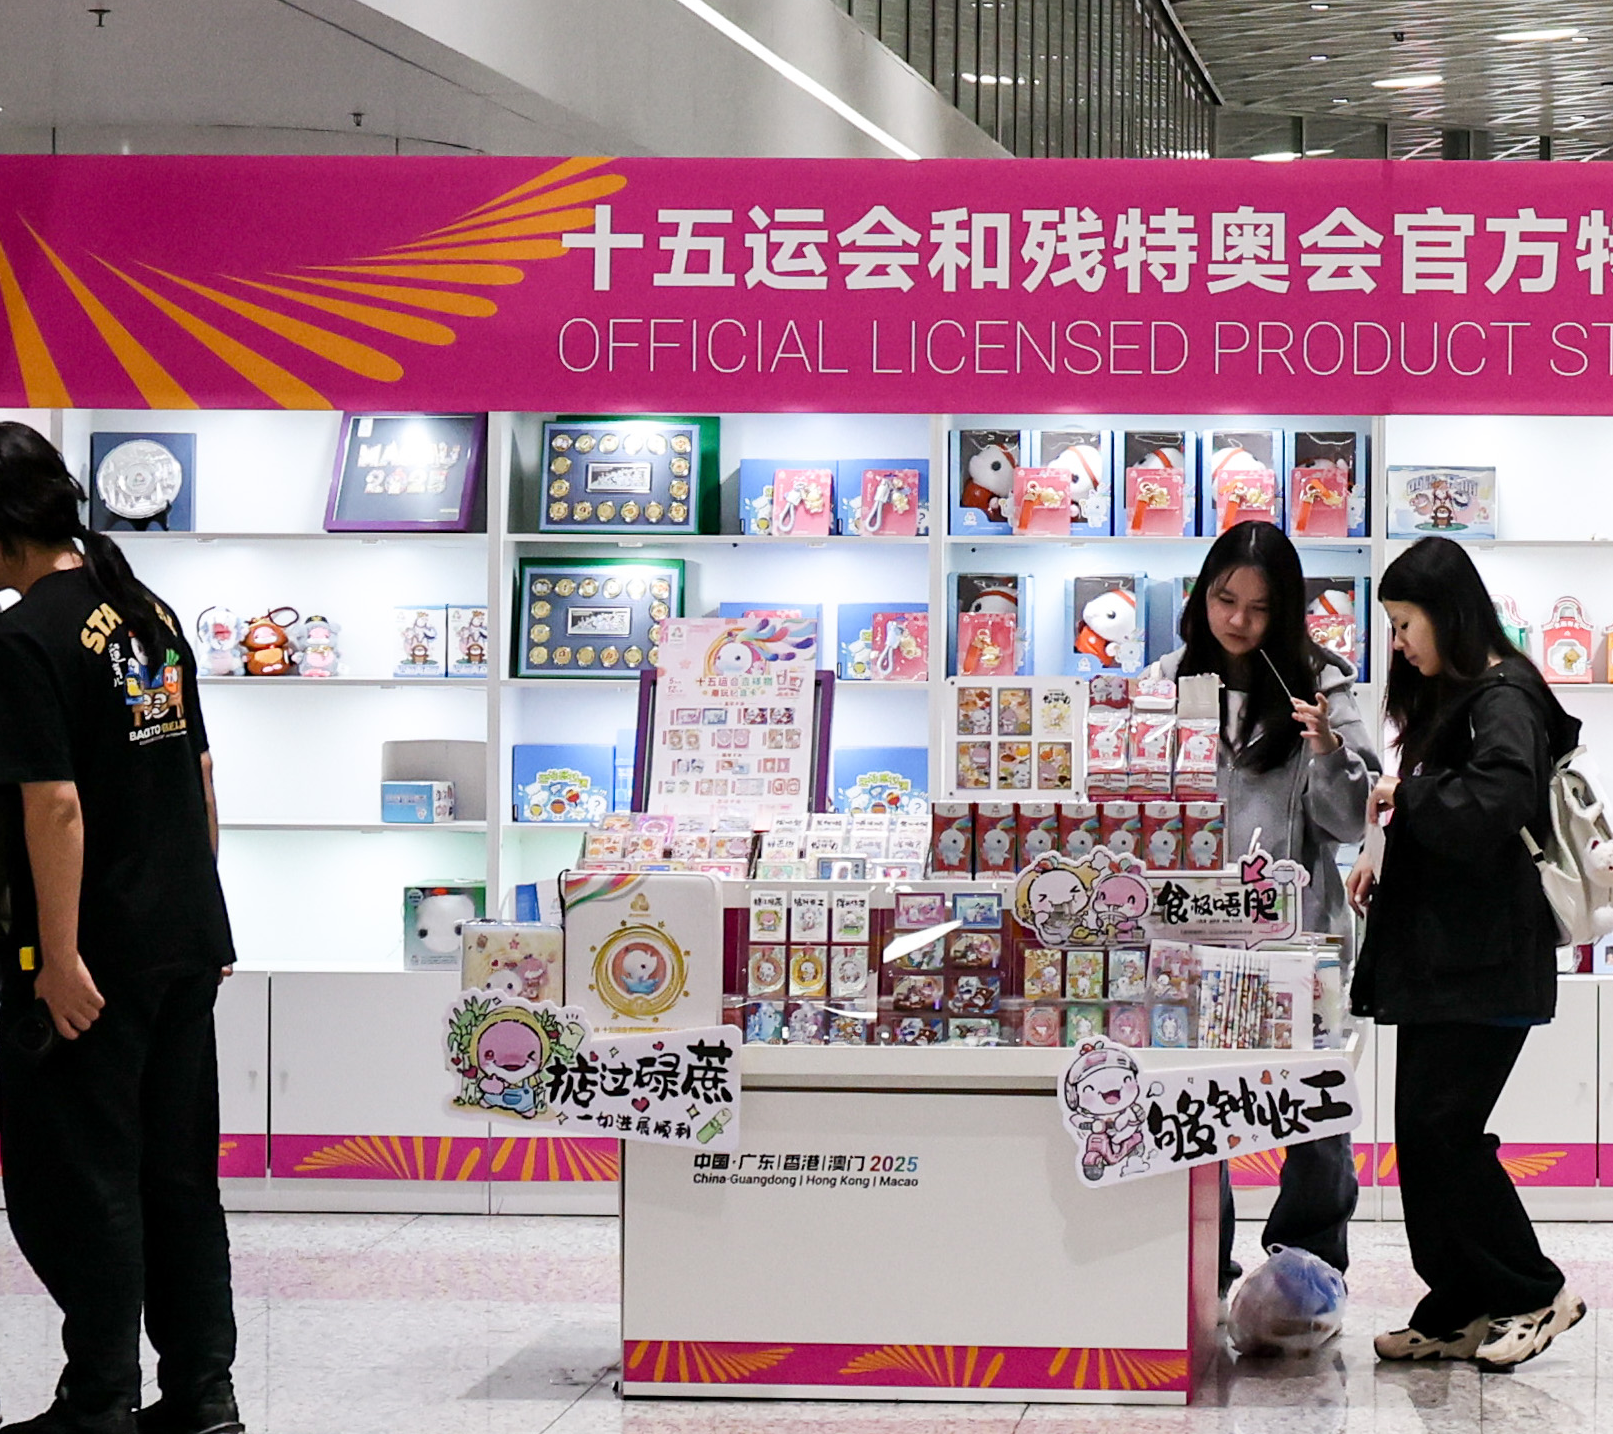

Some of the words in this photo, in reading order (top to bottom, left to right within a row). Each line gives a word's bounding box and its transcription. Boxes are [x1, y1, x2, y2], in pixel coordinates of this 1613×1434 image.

[559, 318, 848, 375] OFFICIAL
[873, 320, 1188, 376] LICENSED
[1215, 321, 1531, 377] PRODUCT
[1157, 880, 1279, 925] 食极唔肥
[545, 1039, 734, 1109] 掂过碌蔗
[576, 1111, 691, 1140] 一切进展顺利
[1146, 1069, 1353, 1163] 够钟收工
[806, 1175, 837, 1188] Hong
[840, 1175, 870, 1188] Kong
[879, 1176, 919, 1187] Macao
[869, 1155, 919, 1173] 2025
